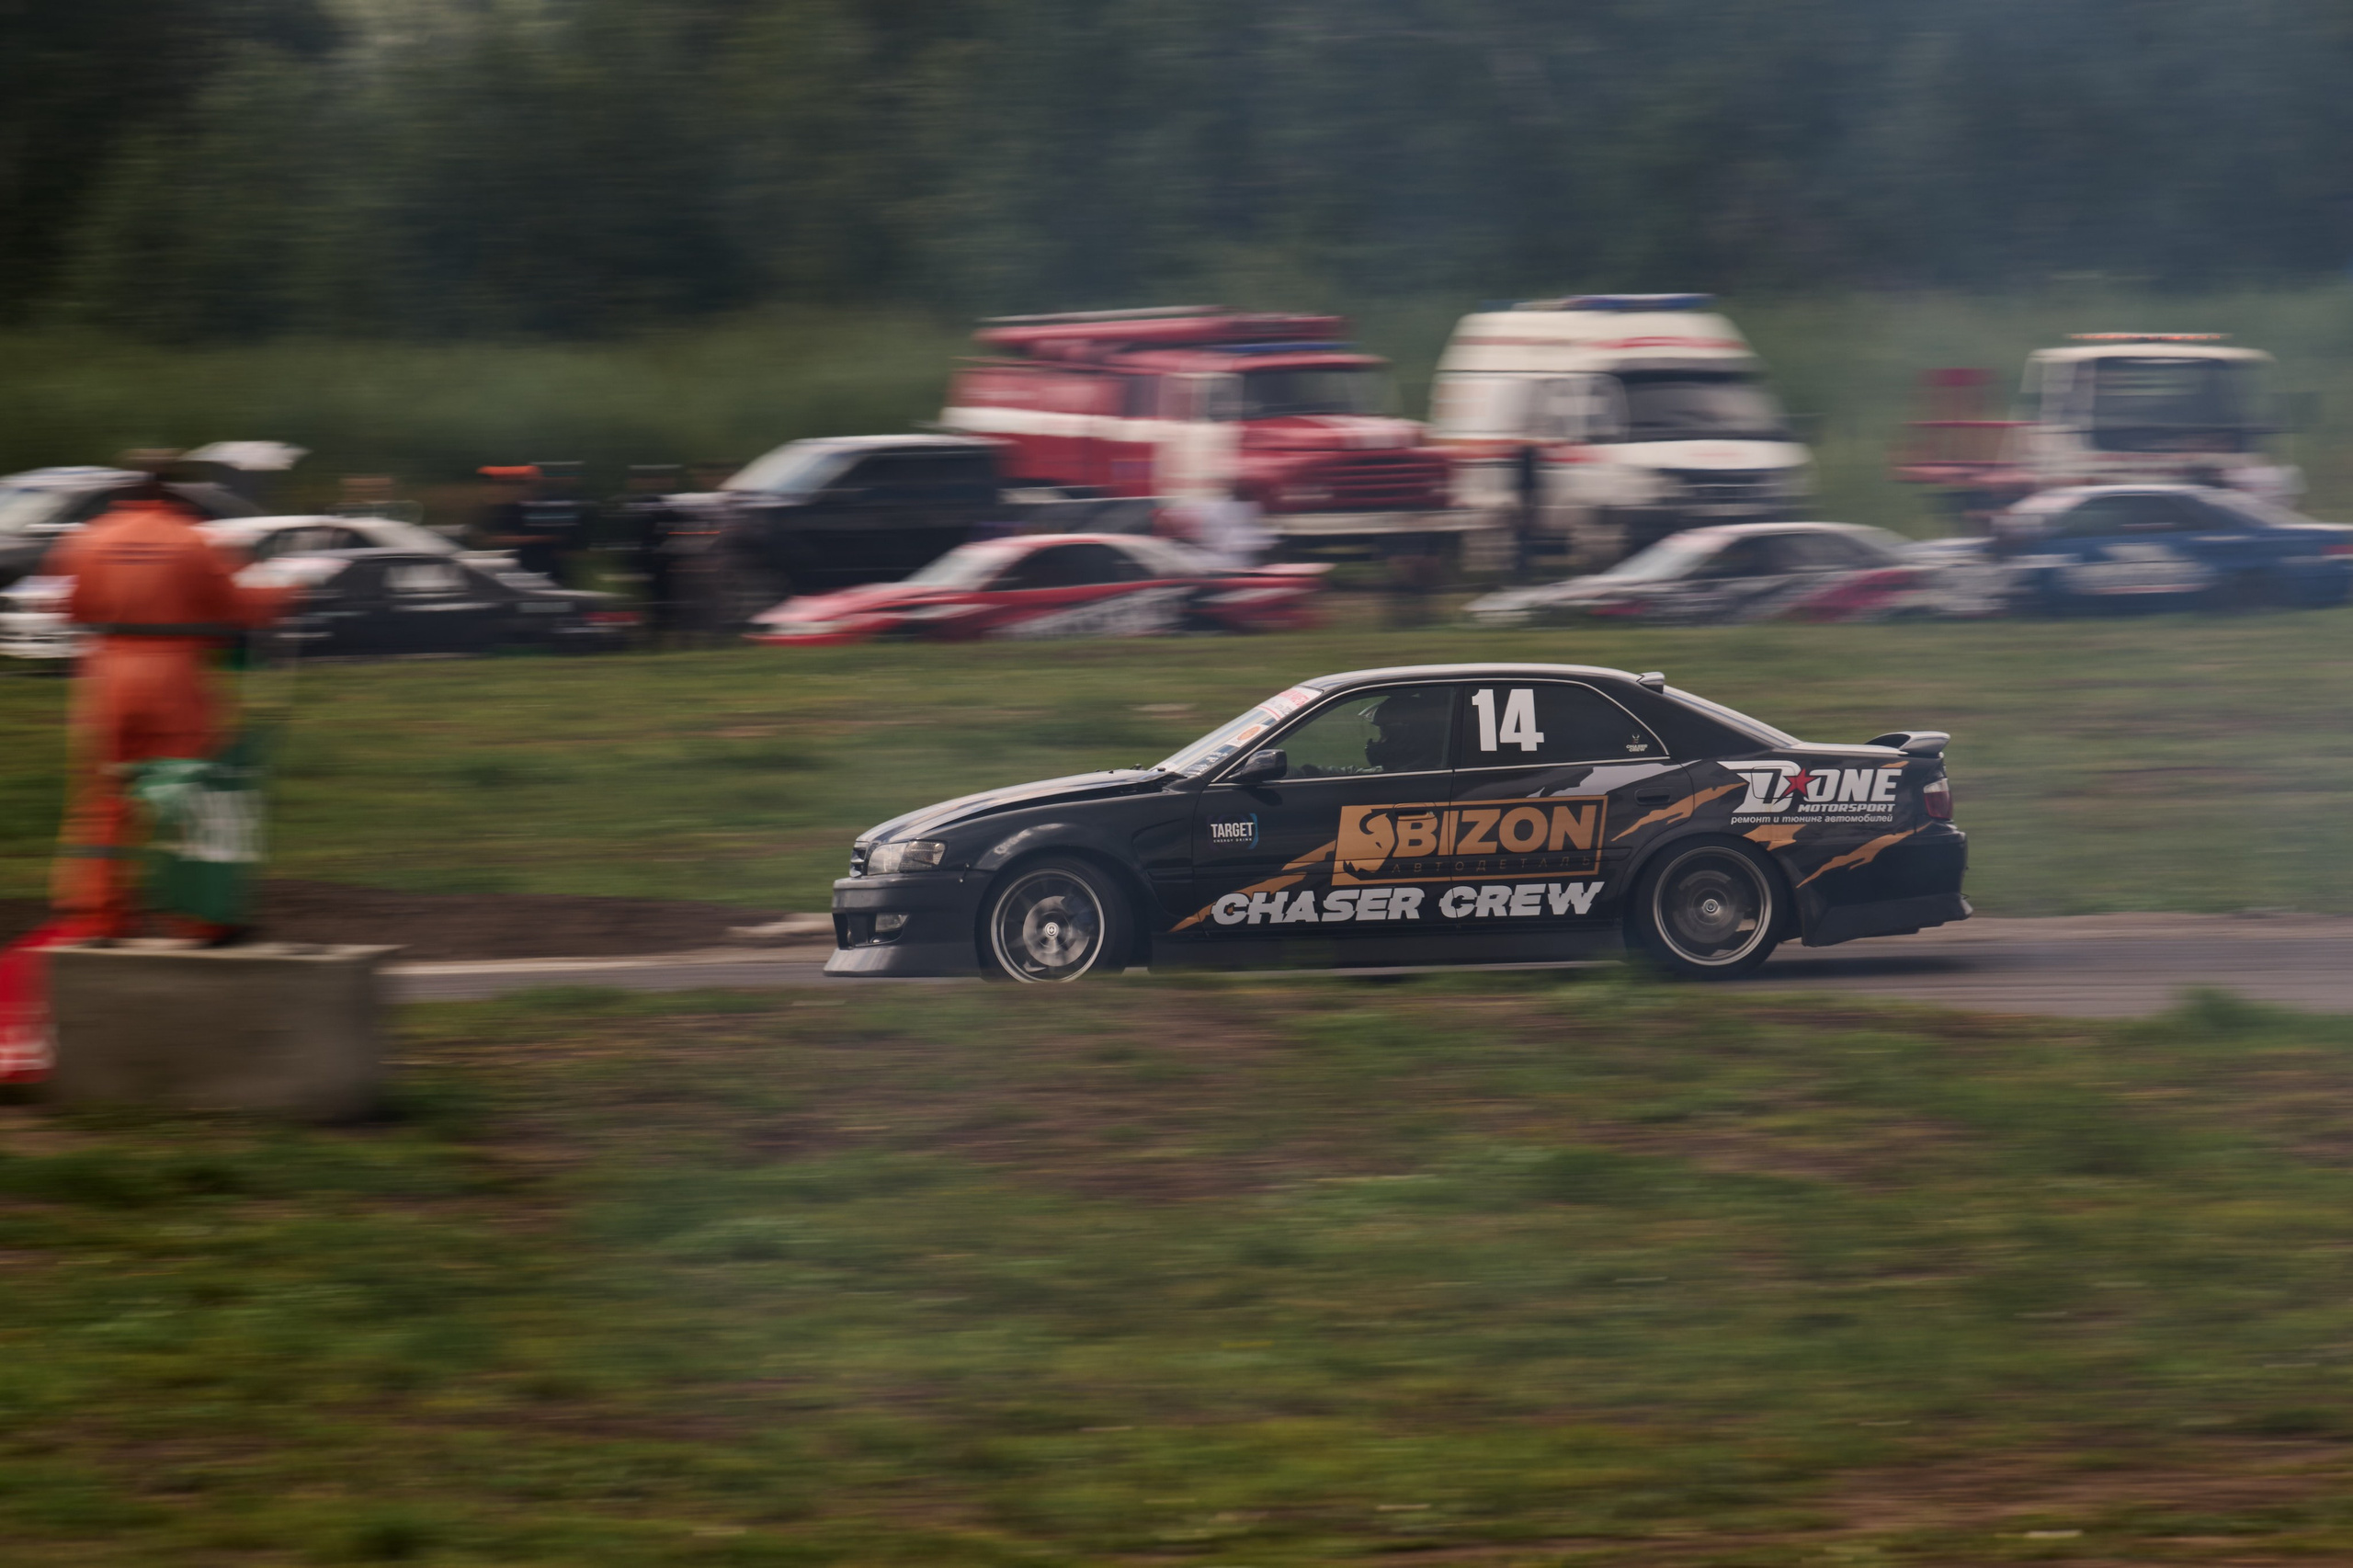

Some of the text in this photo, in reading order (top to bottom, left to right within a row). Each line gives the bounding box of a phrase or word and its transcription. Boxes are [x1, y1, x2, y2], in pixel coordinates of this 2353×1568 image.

[1472, 688, 1544, 751] 14
[1797, 803, 1896, 812] MOTORSPORT
[1731, 816, 1770, 824] ремонт
[1781, 815, 1822, 824] тюнинг
[1824, 813, 1893, 824] автомобилей
[1210, 822, 1254, 837] TARGET
[1392, 804, 1597, 858] BIZON
[1392, 857, 1590, 872] АВТОДЕТАЛЬ
[1211, 881, 1605, 926] CHASER CREW
